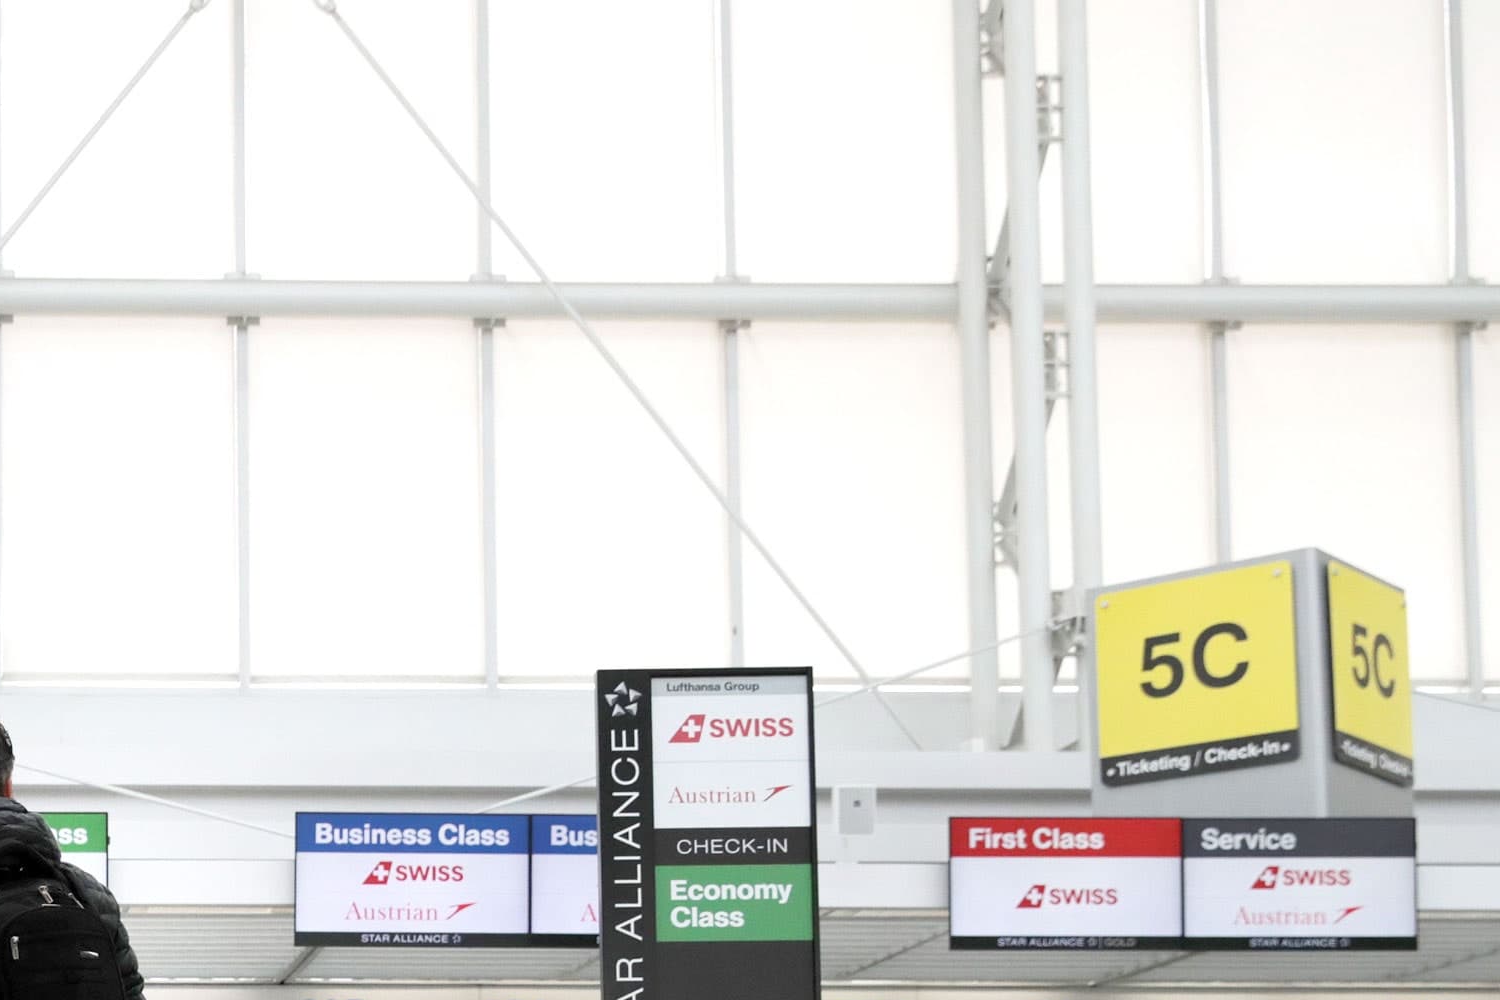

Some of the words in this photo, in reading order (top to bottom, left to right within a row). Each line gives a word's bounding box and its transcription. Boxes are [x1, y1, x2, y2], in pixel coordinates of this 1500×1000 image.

[1140, 622, 1249, 698] 5C
[1352, 623, 1396, 698] 5C
[666, 681, 721, 692] Lufthansa
[724, 681, 760, 693] Group
[710, 718, 794, 738] SWISS
[1116, 754, 1191, 778] Ticketing
[1204, 741, 1280, 765] Check-In
[668, 786, 756, 804] Austrian
[314, 823, 432, 845] Business
[438, 823, 510, 846] Class
[610, 728, 644, 941] ALLIANCE
[968, 827, 1028, 849] First
[1032, 827, 1105, 850] Class
[1201, 828, 1297, 850] Service
[676, 838, 789, 855] CHECK-IN
[395, 865, 464, 882] SWISS
[1283, 869, 1350, 887] SWISS
[669, 879, 793, 904] Economy
[1050, 888, 1118, 905] SWISS
[344, 901, 438, 920] Austrian
[670, 906, 745, 928] Class
[1234, 906, 1326, 925] Austrian
[361, 933, 390, 944] STAR
[393, 933, 449, 944] ALLIANCE
